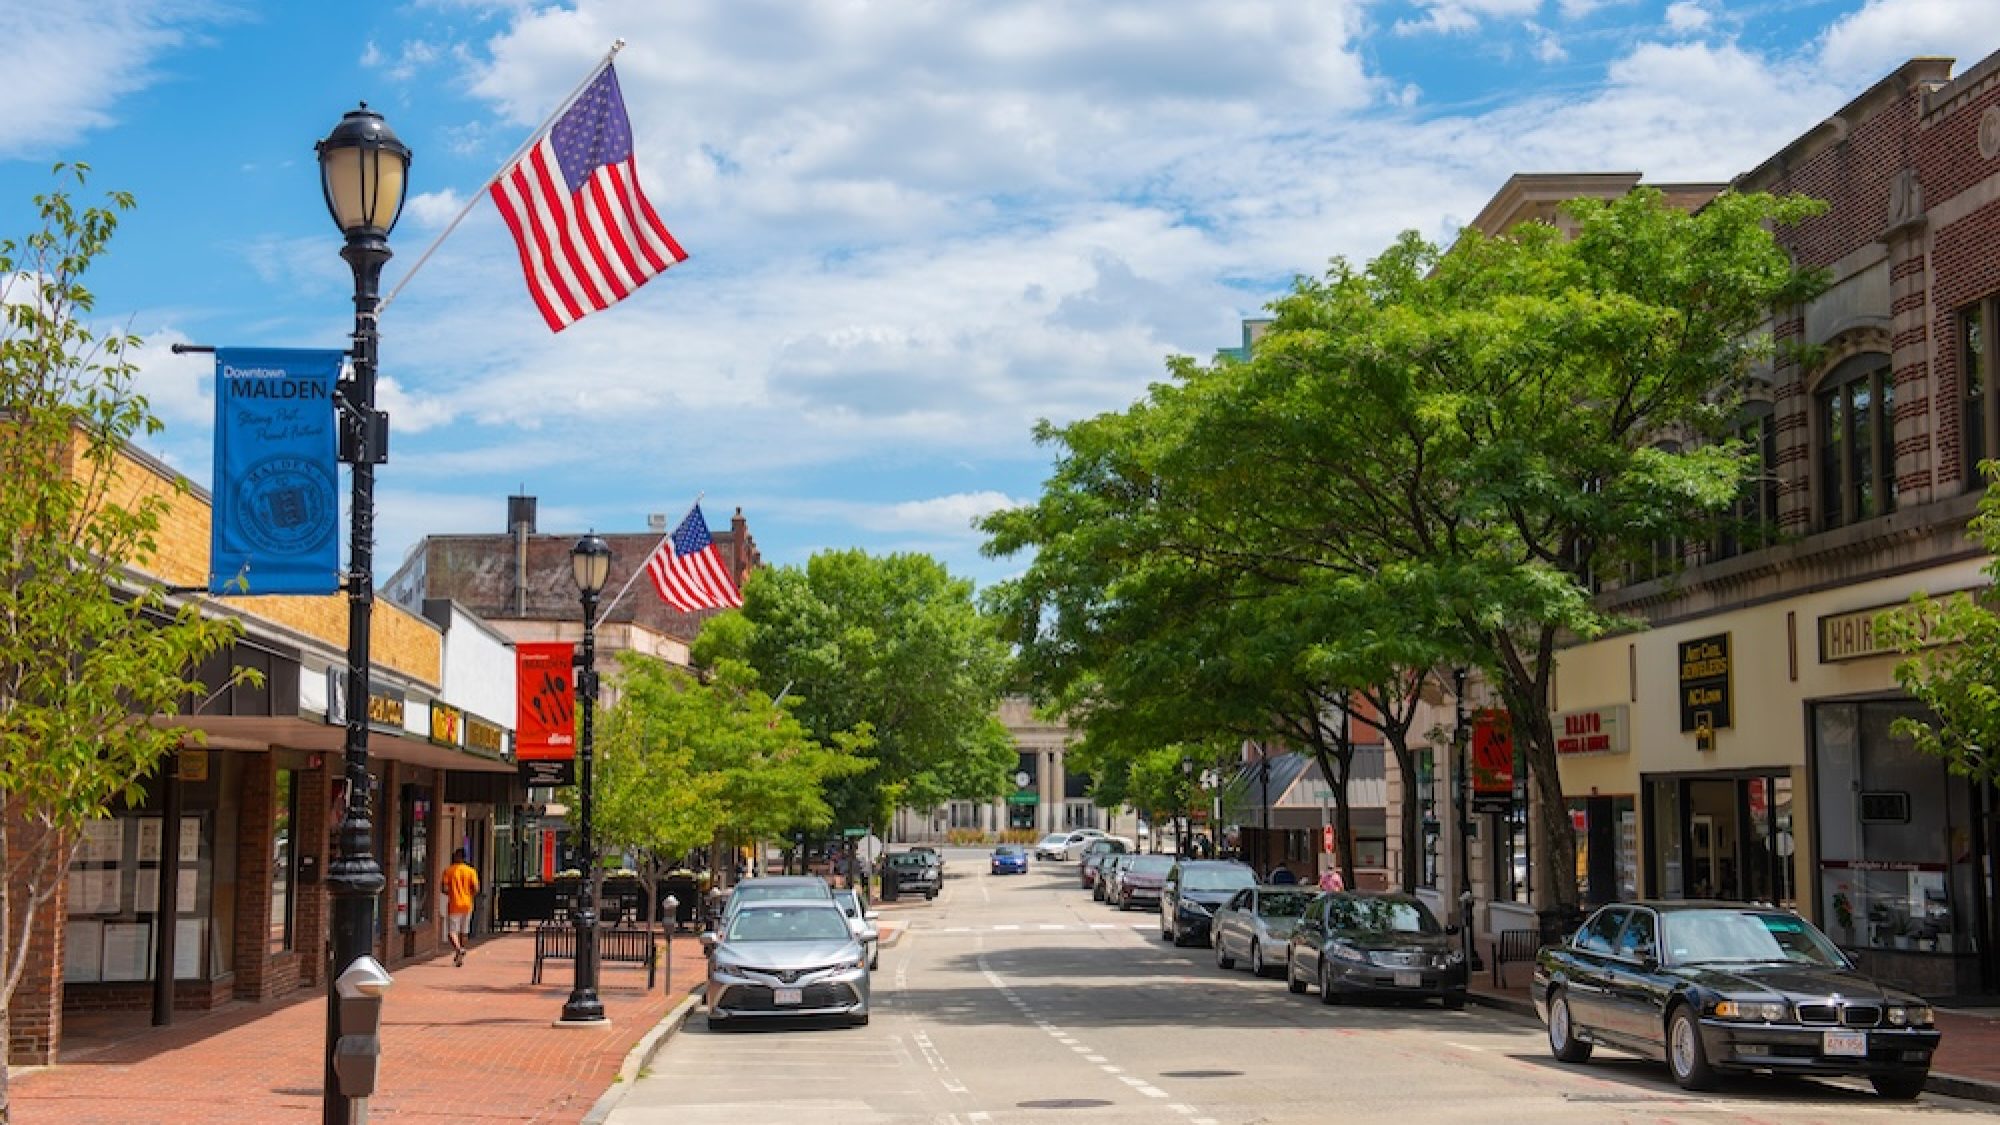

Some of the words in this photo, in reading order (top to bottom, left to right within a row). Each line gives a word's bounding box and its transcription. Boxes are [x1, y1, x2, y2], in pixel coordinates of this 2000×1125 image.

[223, 365, 287, 378] Downtown
[231, 379, 327, 399] MALDEN
[1831, 615, 1873, 657] HAIR
[1681, 656, 1727, 681] JEWELERS
